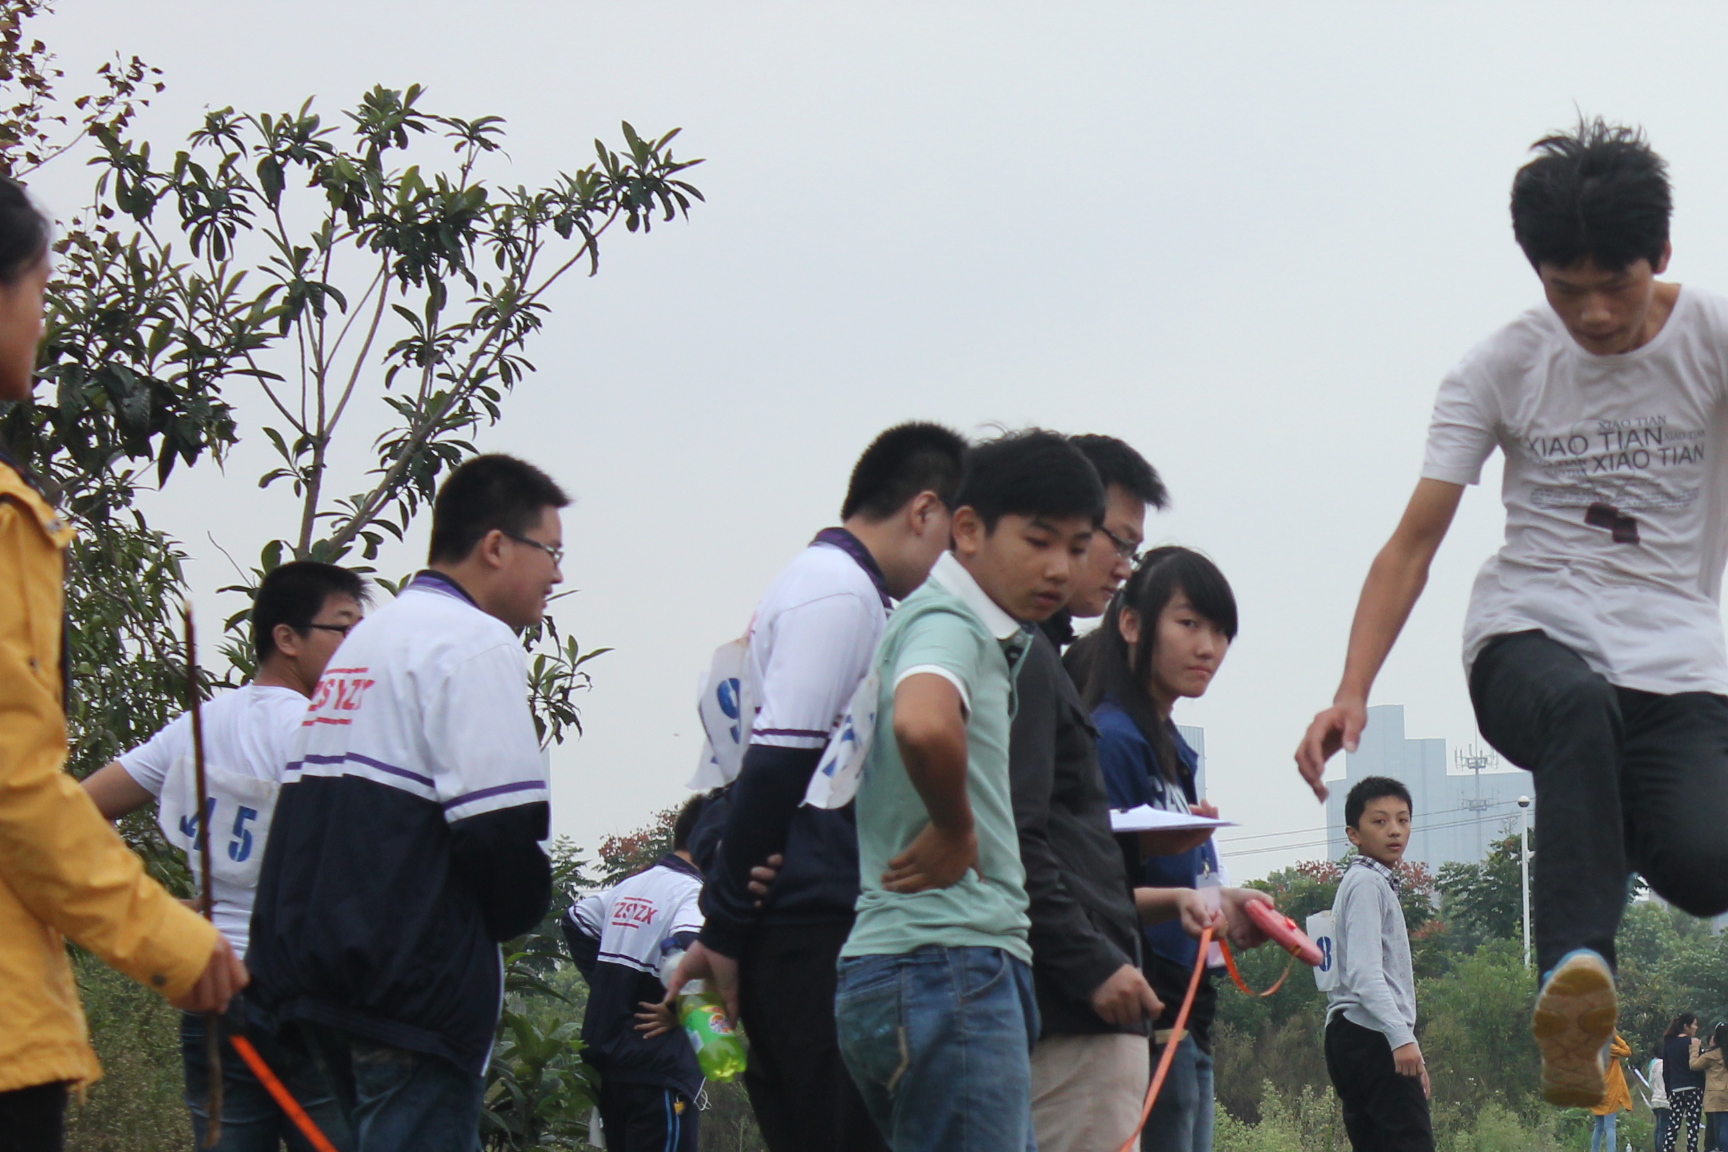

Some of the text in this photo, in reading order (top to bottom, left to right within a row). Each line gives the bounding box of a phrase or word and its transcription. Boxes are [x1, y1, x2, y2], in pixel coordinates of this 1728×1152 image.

[1598, 415, 1667, 431] XIAO TIAN
[1529, 426, 1664, 457] XIAO TIAN
[1592, 443, 1705, 473] XIAO TIAN
